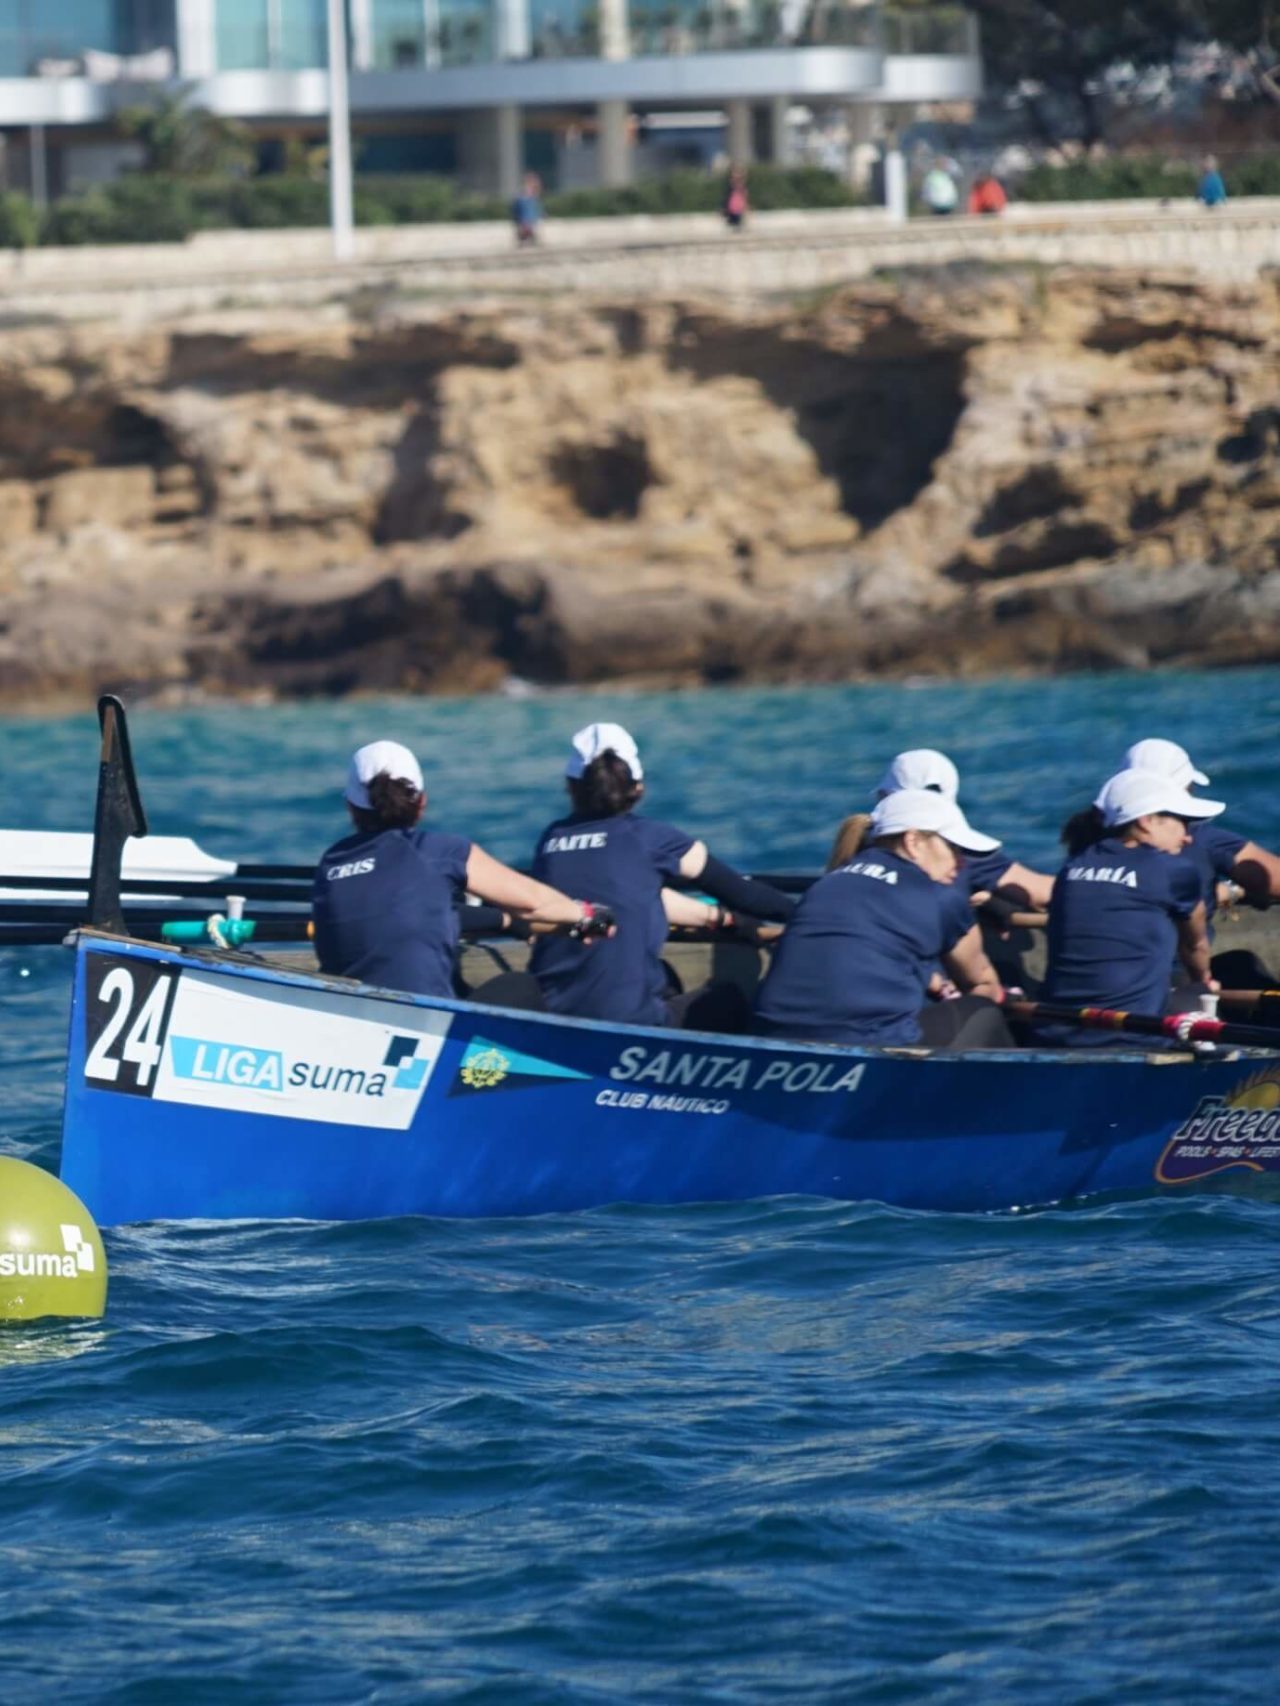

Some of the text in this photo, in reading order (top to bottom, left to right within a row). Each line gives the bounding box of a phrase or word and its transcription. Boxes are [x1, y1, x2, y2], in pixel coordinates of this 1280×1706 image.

[326, 858, 375, 880] CRIS
[84, 968, 172, 1086] 24
[192, 1044, 387, 1097] LIGA suma
[609, 1046, 866, 1092] SANTA POLA
[595, 1089, 649, 1109] CLUB
